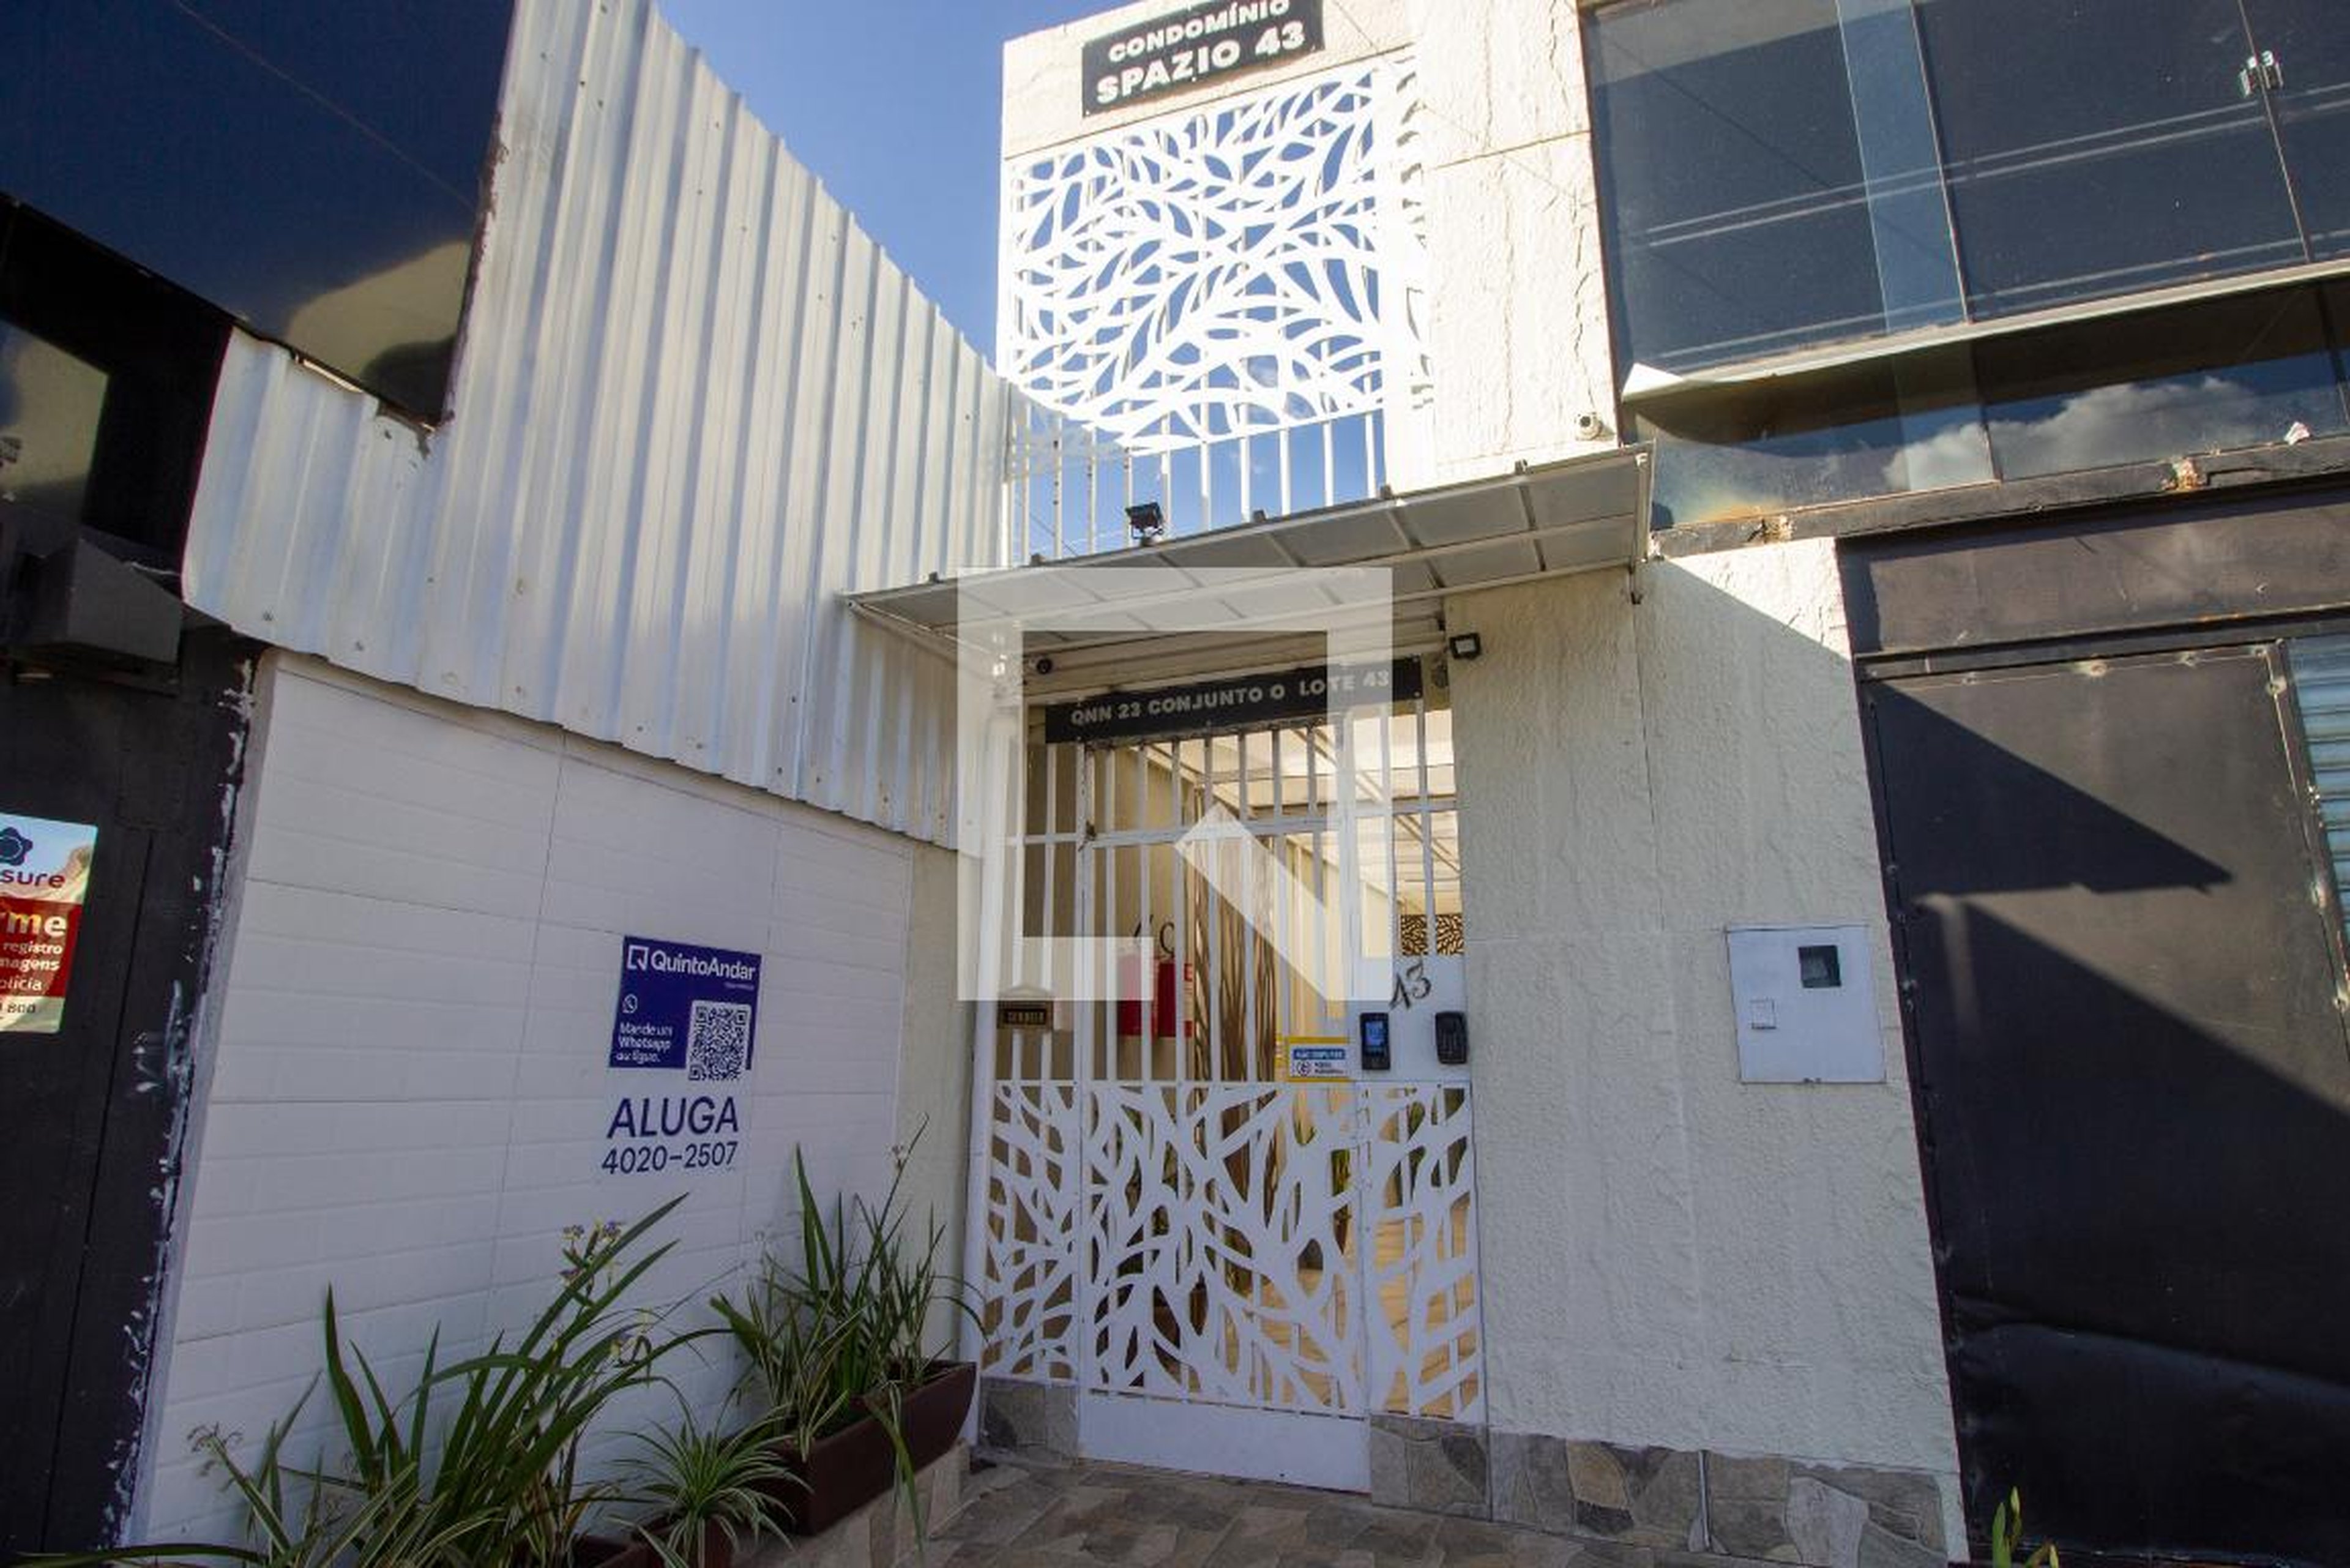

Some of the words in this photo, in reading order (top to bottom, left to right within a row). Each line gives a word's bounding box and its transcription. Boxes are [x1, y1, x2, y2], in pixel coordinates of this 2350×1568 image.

[1108, 0, 1289, 62] CONDOMÍNIO
[1097, 40, 1240, 104] SPAZIO
[1255, 21, 1305, 58] 43
[1072, 704, 1112, 727] QNN
[1148, 687, 1264, 715] CONJUNTO
[1299, 673, 1355, 696] LOTE
[1363, 670, 1390, 688] 43
[0, 912, 67, 938] me
[3, 940, 63, 956] registro
[651, 949, 756, 980] QuintoAndar
[606, 1096, 739, 1139] ALUGA
[602, 1141, 739, 1175] 4020-2507
